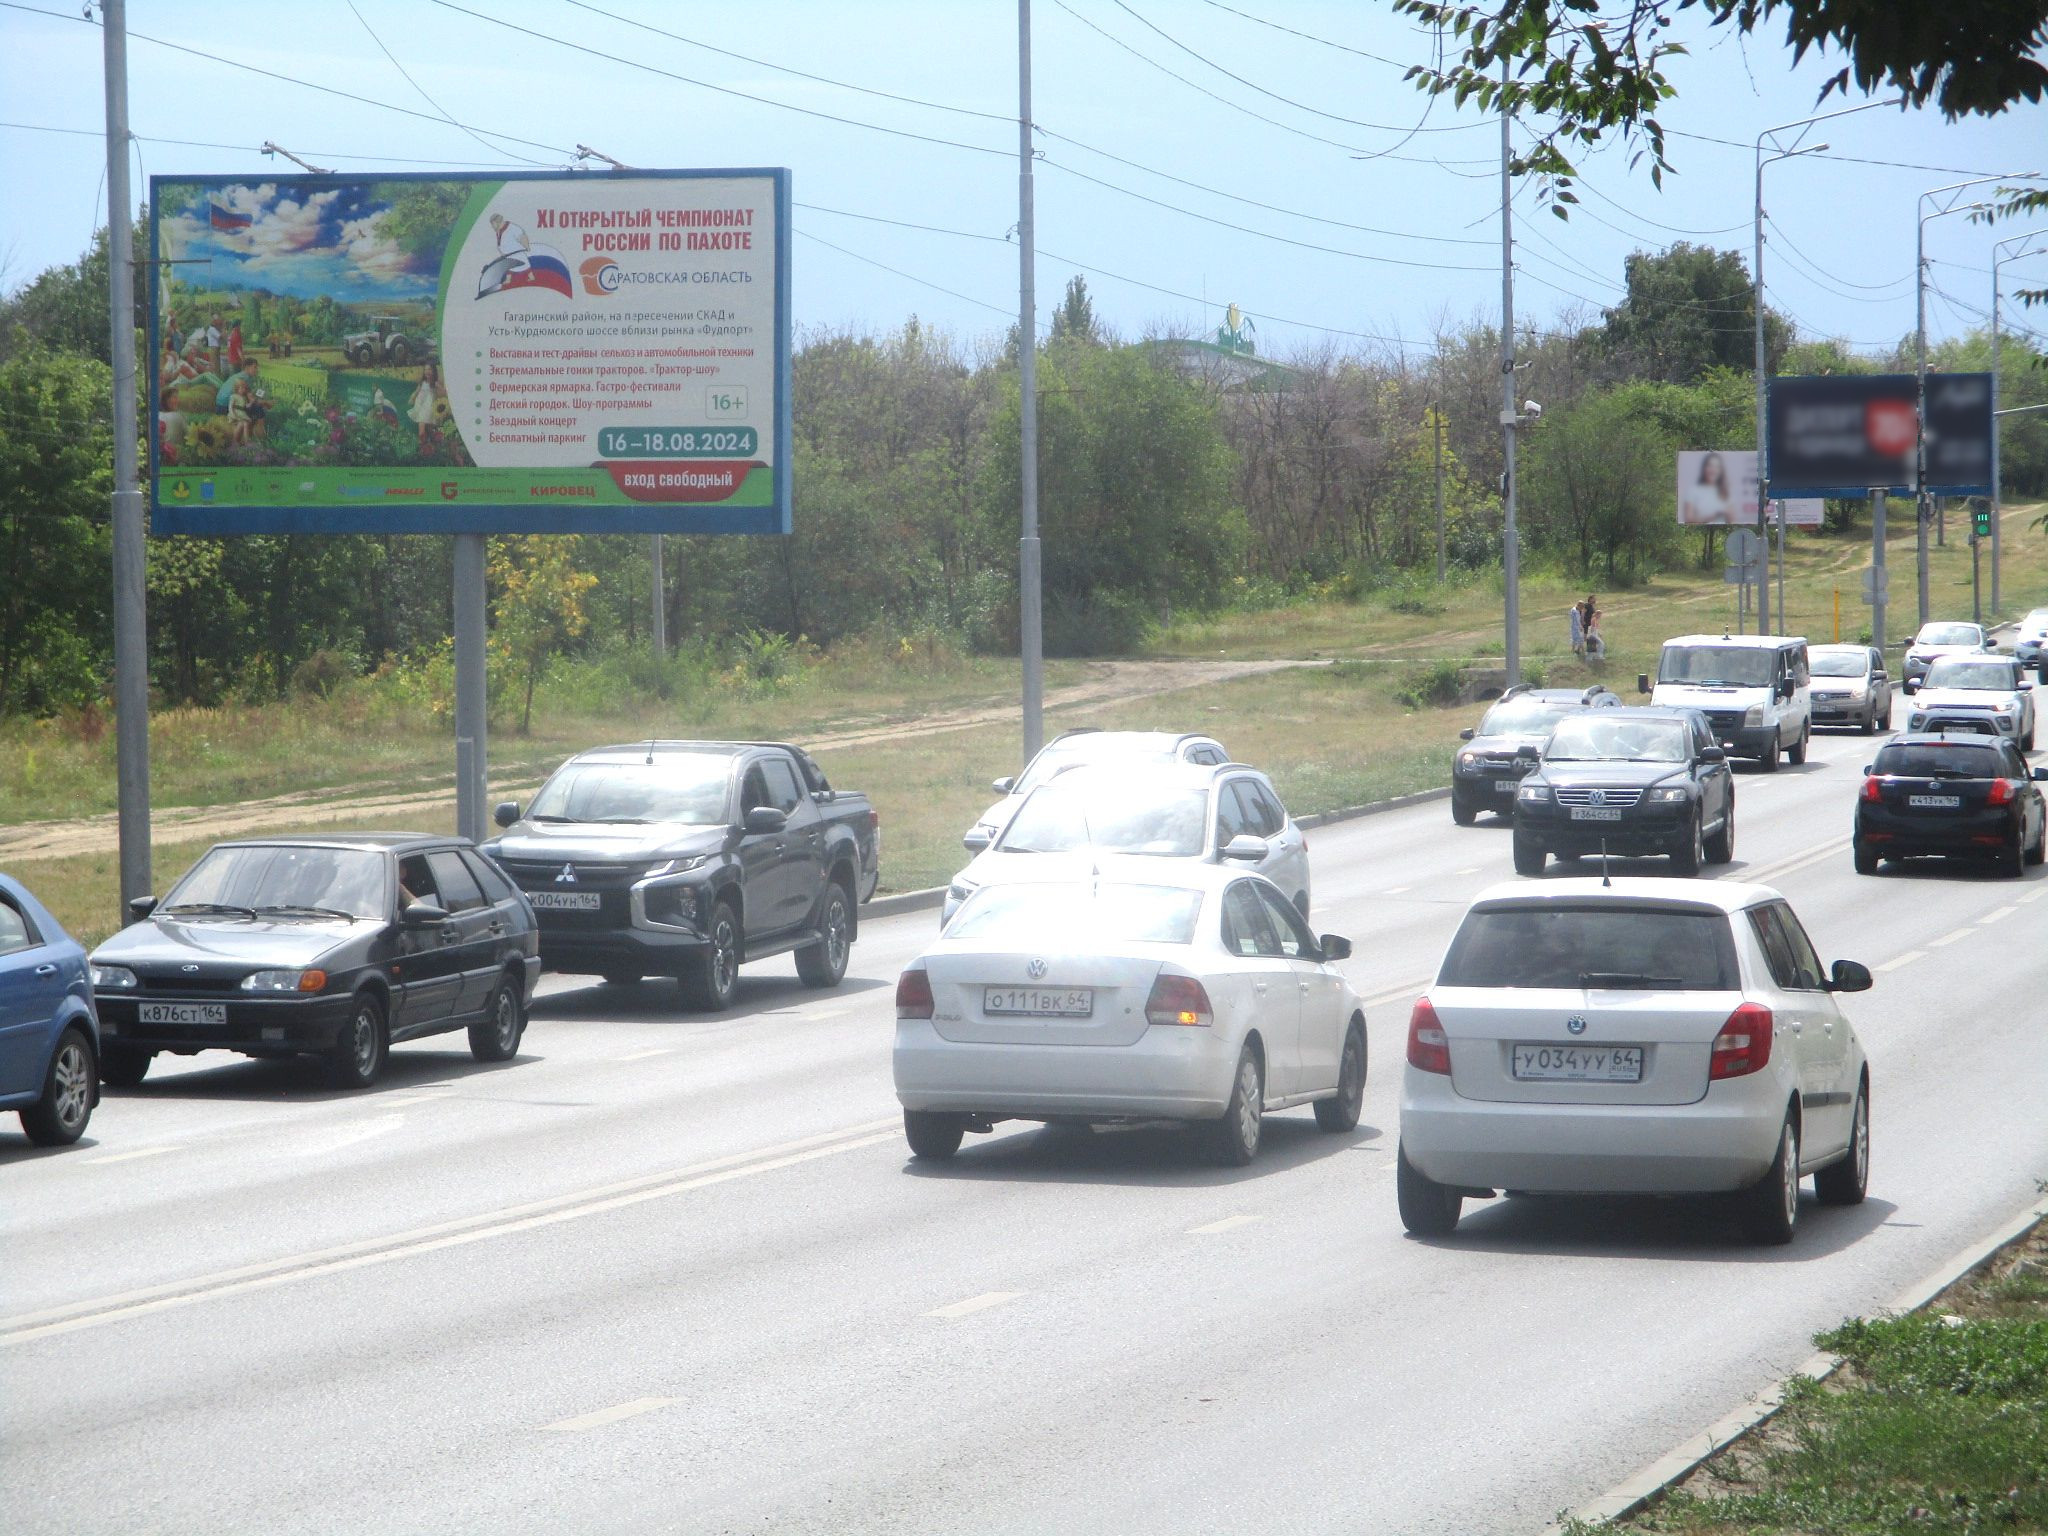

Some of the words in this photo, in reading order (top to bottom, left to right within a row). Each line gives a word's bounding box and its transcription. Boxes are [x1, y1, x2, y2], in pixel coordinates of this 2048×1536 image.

[559, 208, 651, 228] ОТКРЫТЫЙ
[656, 209, 754, 227] ЧЕМПИОНАТ
[582, 233, 650, 251] РОССИИ
[659, 232, 681, 251] ПО
[687, 232, 752, 250] ПАХОТЕ
[600, 265, 687, 292] САРАТОВСКАЯ
[692, 271, 752, 283] ОБЛАСТЬ
[504, 311, 569, 323] Гагаринский
[572, 312, 607, 323] район,
[610, 312, 621, 320] на
[697, 310, 725, 320] СКАД
[729, 312, 735, 320] и
[489, 326, 584, 337] Усть-Курдюмского
[587, 327, 618, 336] шоссе
[622, 325, 658, 335] вблизи
[662, 327, 694, 337] рынка
[699, 324, 753, 337] «Фудпорт»
[489, 348, 533, 359] Выставка
[535, 349, 540, 358] и
[542, 348, 598, 360] тест-драйвы
[601, 349, 636, 358] сельхоз
[637, 349, 643, 358] и
[644, 347, 716, 357] автомобильной
[718, 349, 754, 357] техники
[489, 365, 565, 377] Экстремальные
[567, 366, 593, 375] гонки
[596, 366, 648, 376] тракторов.
[650, 363, 721, 376] «Трактор-шоу»
[489, 382, 547, 394] Фермерская
[550, 383, 594, 394] ярмарка.
[596, 380, 681, 394] Гастро-фестивали
[489, 398, 527, 411] Детский
[530, 400, 570, 412] городок.
[572, 399, 652, 411] Шоу-программы
[711, 394, 744, 410] 16+
[489, 415, 536, 428] Звездный
[539, 417, 577, 428] концерт
[489, 432, 545, 443] Бесплатный
[548, 434, 587, 445] паркинг
[530, 485, 596, 498] КИРОВЕЦ
[530, 894, 577, 907] К004УН
[580, 894, 597, 904] 164
[1068, 992, 1085, 1006] 64
[144, 1006, 198, 1022] К876СТ
[201, 1006, 222, 1018] 164
[1524, 1050, 1606, 1070] У034УУ
[1612, 1051, 1634, 1066] 64
